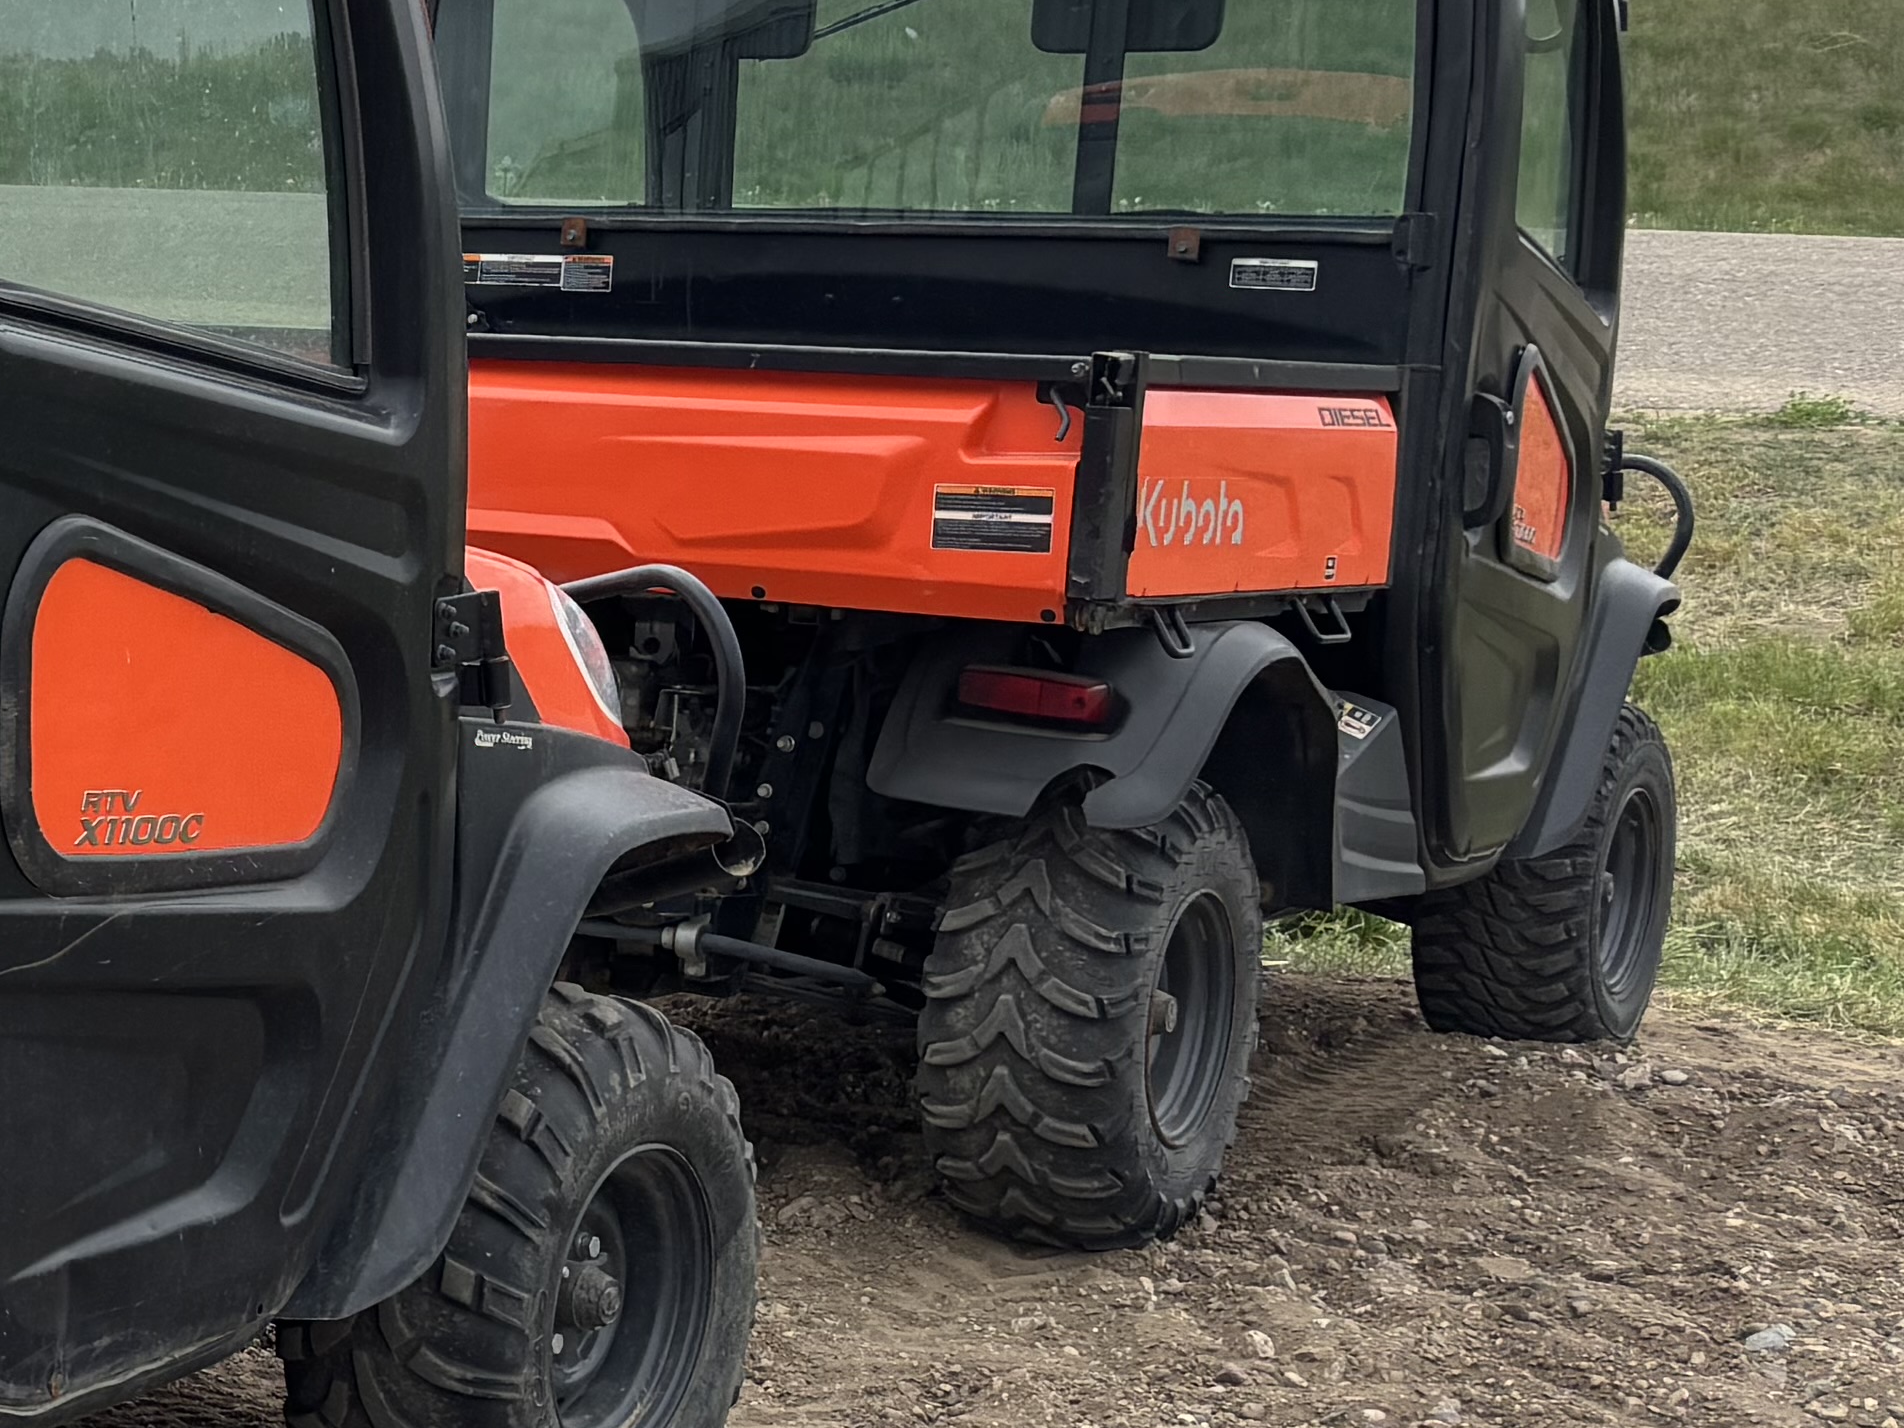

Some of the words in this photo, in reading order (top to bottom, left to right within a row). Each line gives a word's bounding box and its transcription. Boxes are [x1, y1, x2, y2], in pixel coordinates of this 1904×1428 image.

[1317, 407, 1391, 428] DIESEL
[1141, 478, 1243, 548] Kubota
[80, 789, 143, 813] RTV
[74, 812, 205, 846] X1100C
